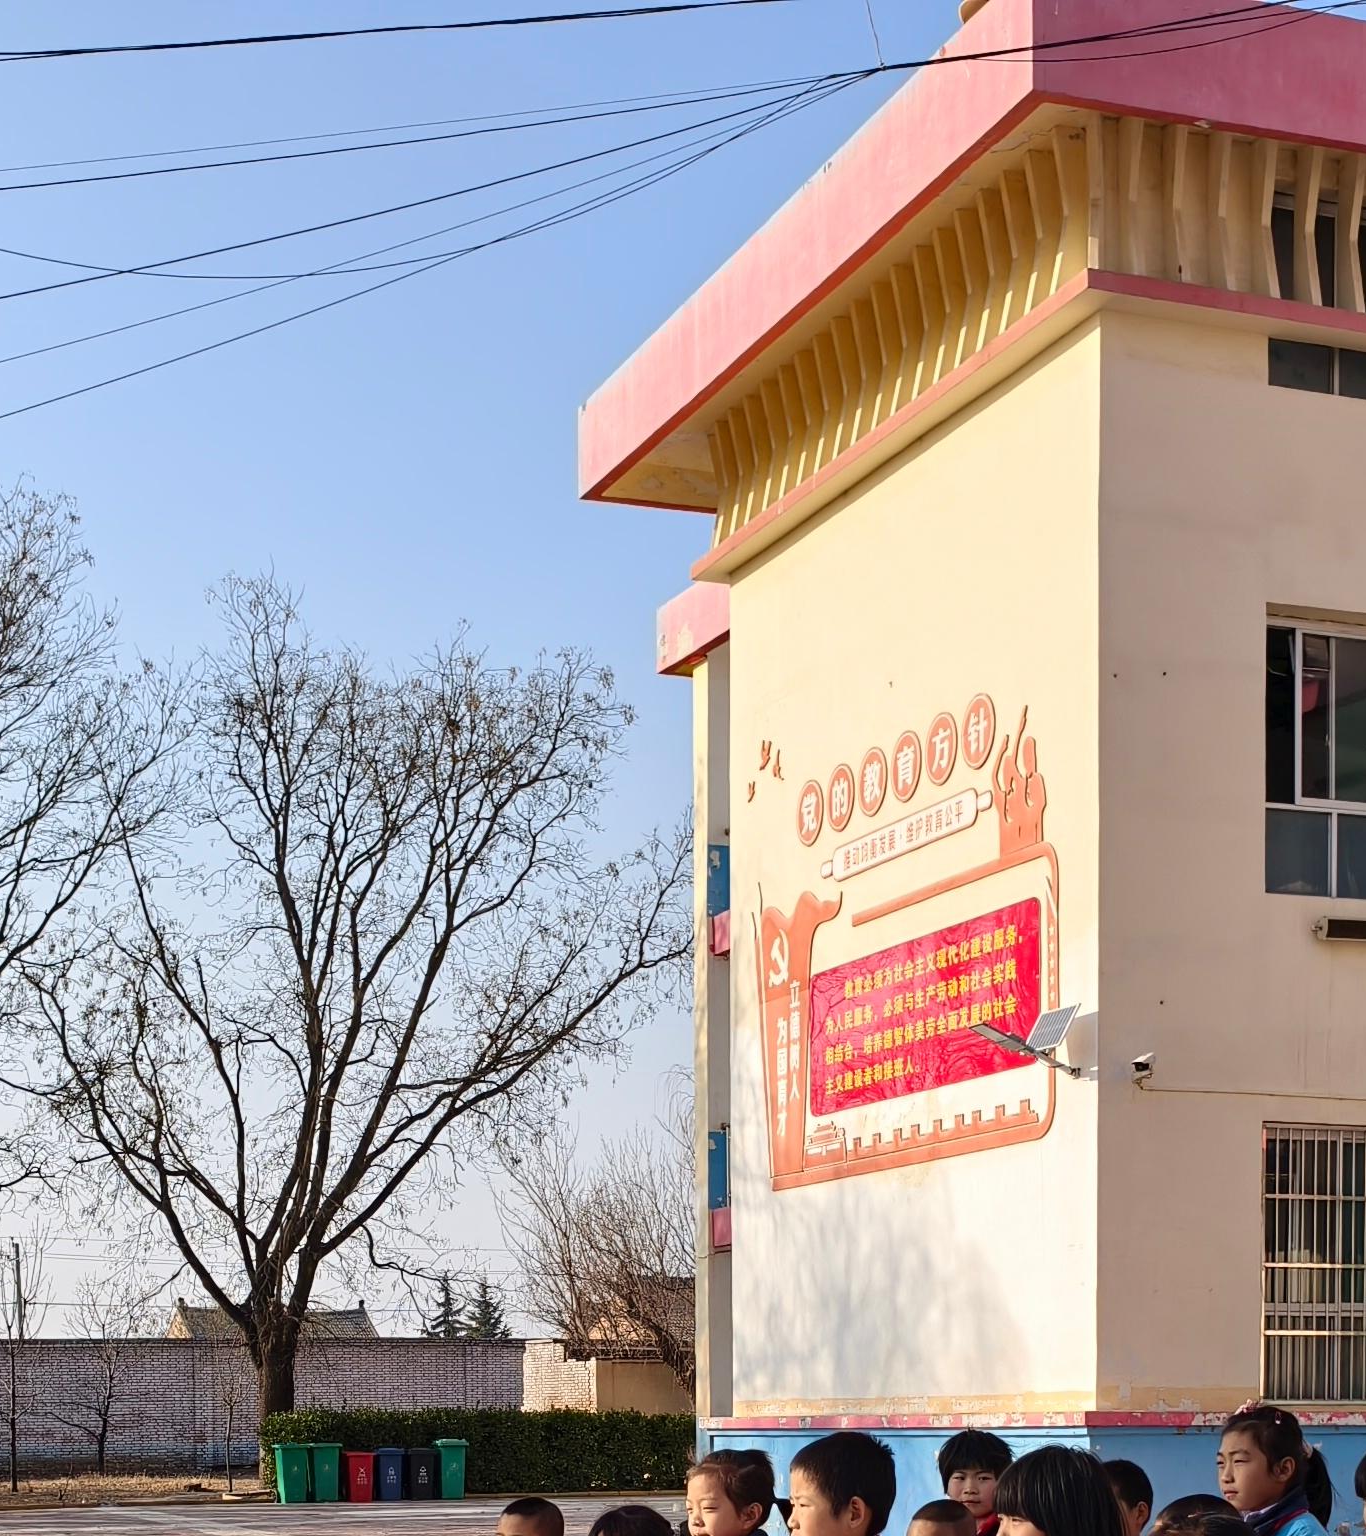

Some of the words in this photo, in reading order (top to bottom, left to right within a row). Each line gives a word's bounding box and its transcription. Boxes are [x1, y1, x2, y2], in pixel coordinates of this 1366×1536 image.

[801, 706, 989, 835] 党的教育方针
[789, 980, 800, 1102] 立德树人
[825, 958, 1017, 1036] 为人民服务，必须与生产劳动和社会实践
[776, 1018, 789, 1138] 为国育才
[825, 1055, 922, 1096] 主义建设者和接班人。
